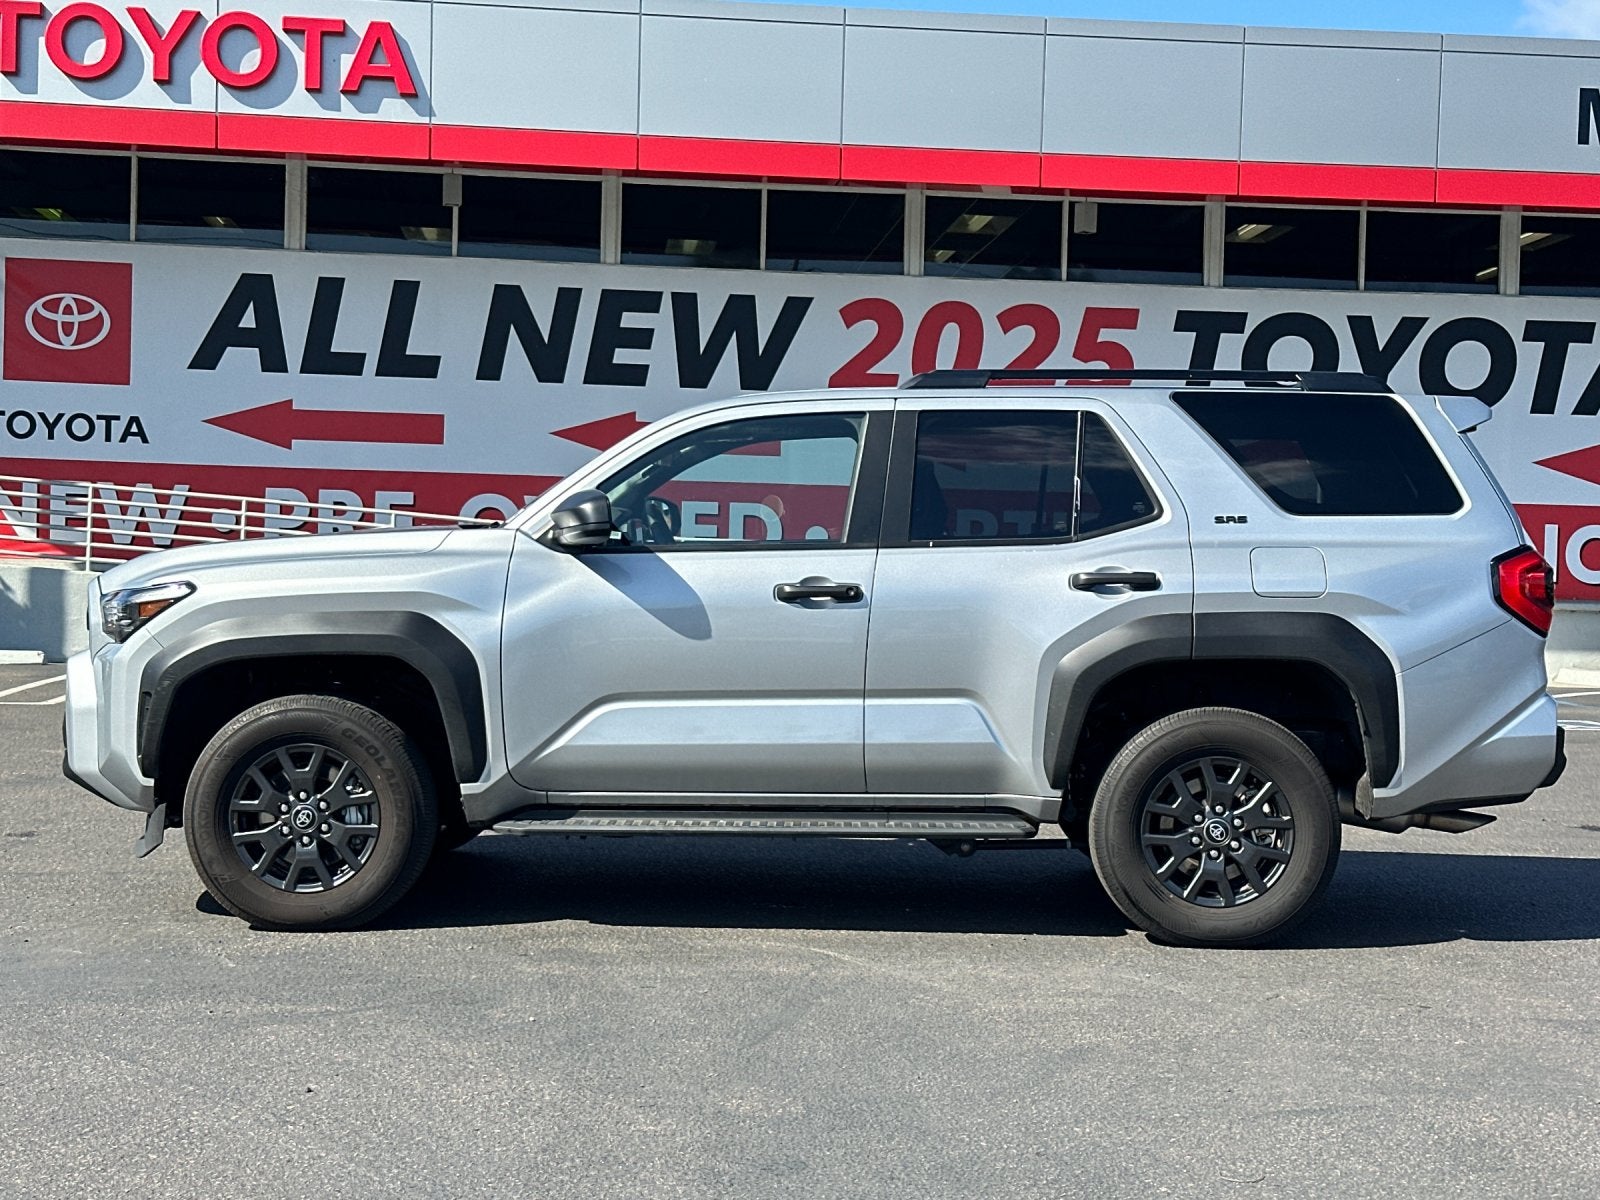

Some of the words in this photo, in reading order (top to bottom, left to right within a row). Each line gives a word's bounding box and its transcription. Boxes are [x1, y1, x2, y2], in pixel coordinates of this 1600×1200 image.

[0, 1, 417, 97] TOYOTA
[187, 272, 442, 379] ALL
[475, 283, 815, 391] NEW
[828, 297, 1140, 388] 2025
[0, 410, 150, 444] OYOTA
